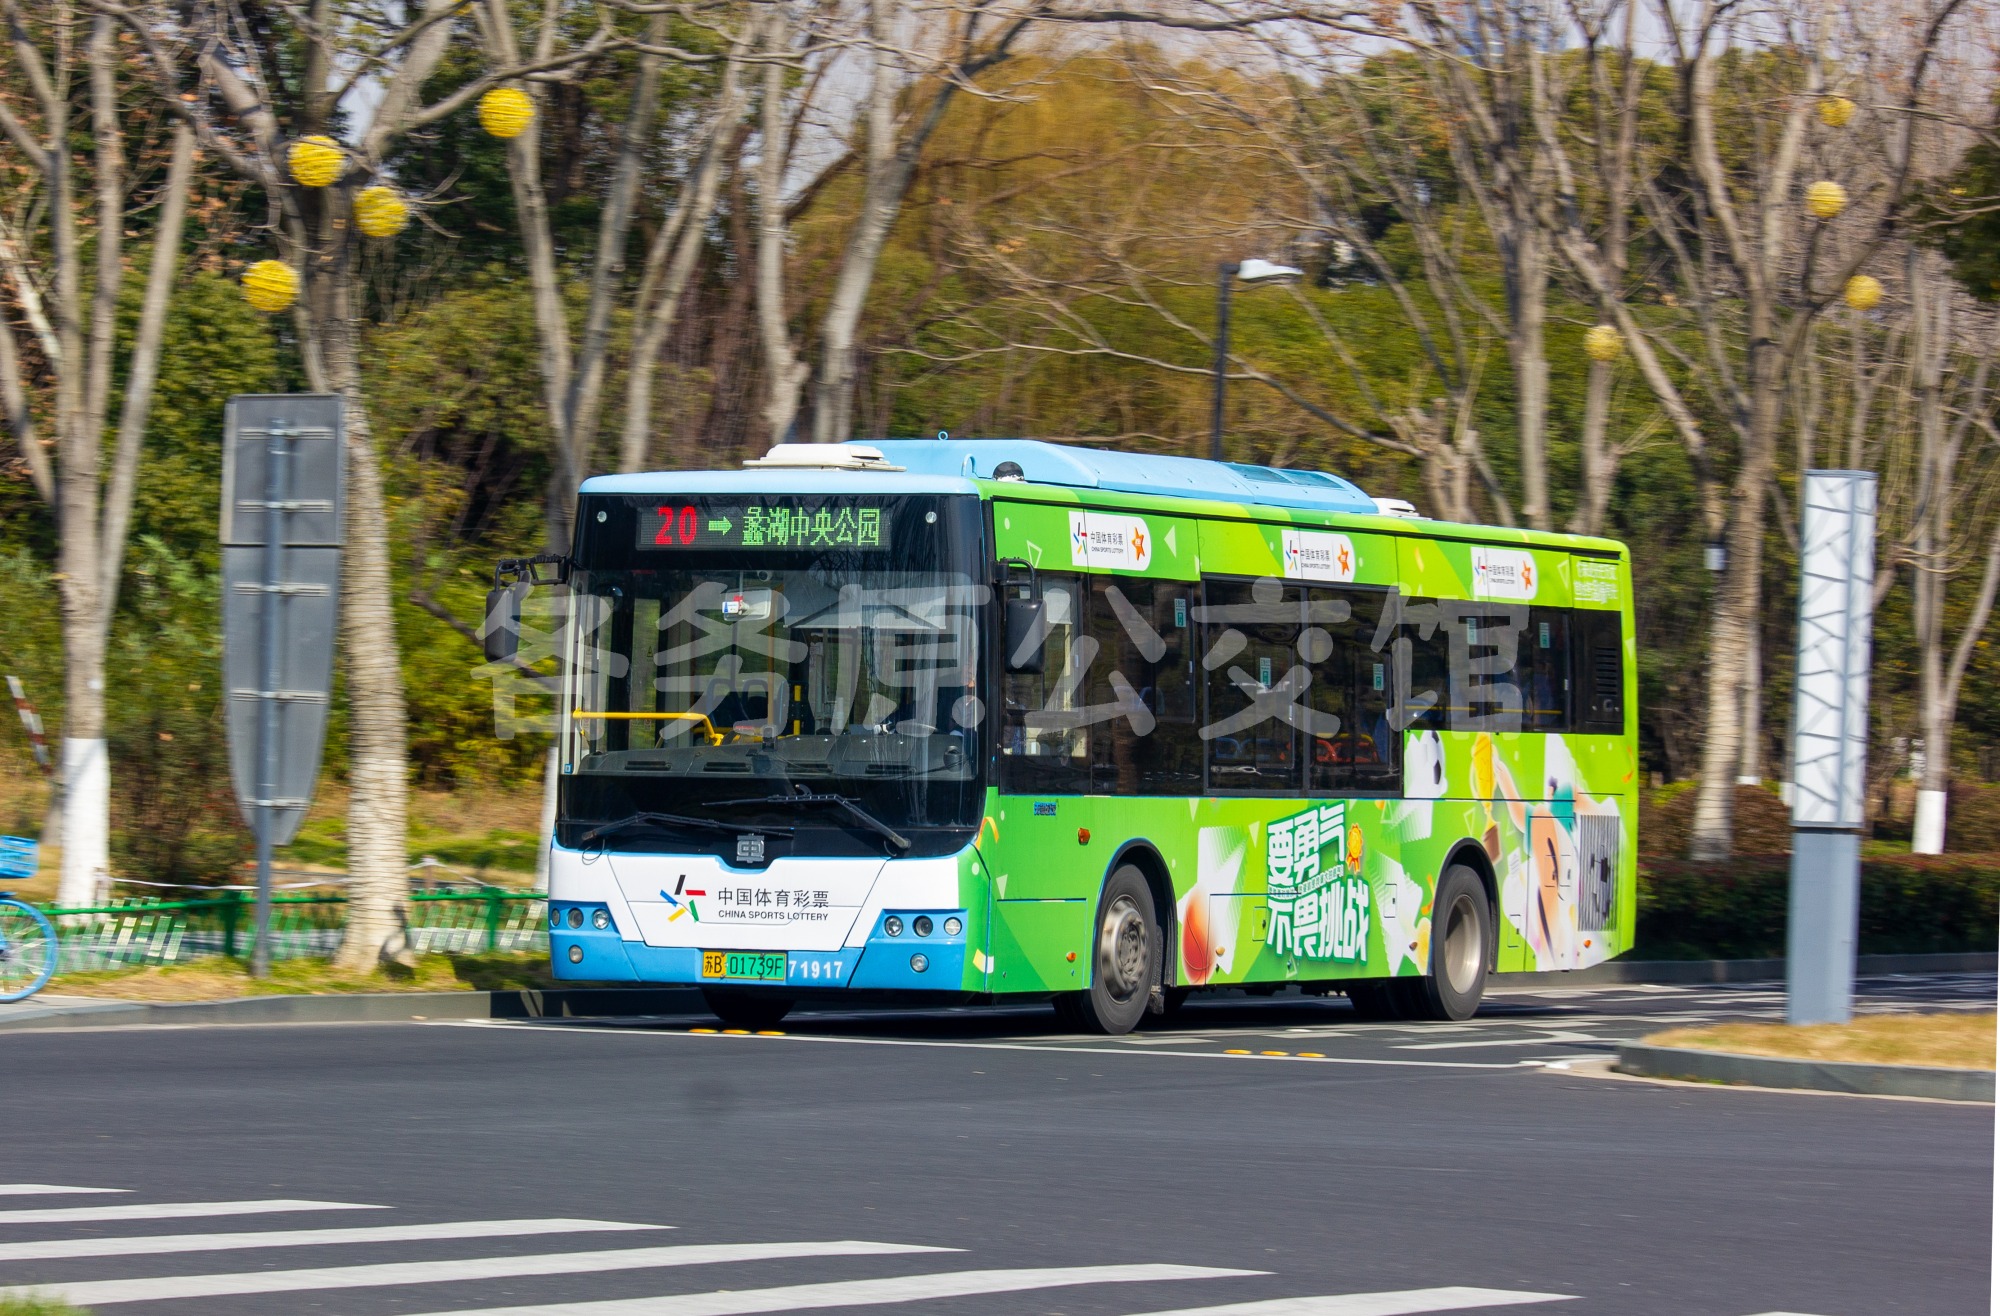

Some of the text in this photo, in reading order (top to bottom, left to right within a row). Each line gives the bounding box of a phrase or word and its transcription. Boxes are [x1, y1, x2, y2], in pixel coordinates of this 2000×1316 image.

[655, 506, 880, 546] 20 蠡湖中央公园
[1268, 803, 1345, 887] 要勇气
[718, 887, 829, 908] 中国体育彩票
[718, 910, 828, 920] CHINA SPORTS LOTTERY
[1267, 877, 1370, 963] 不畏挑战
[788, 960, 843, 978] 71917
